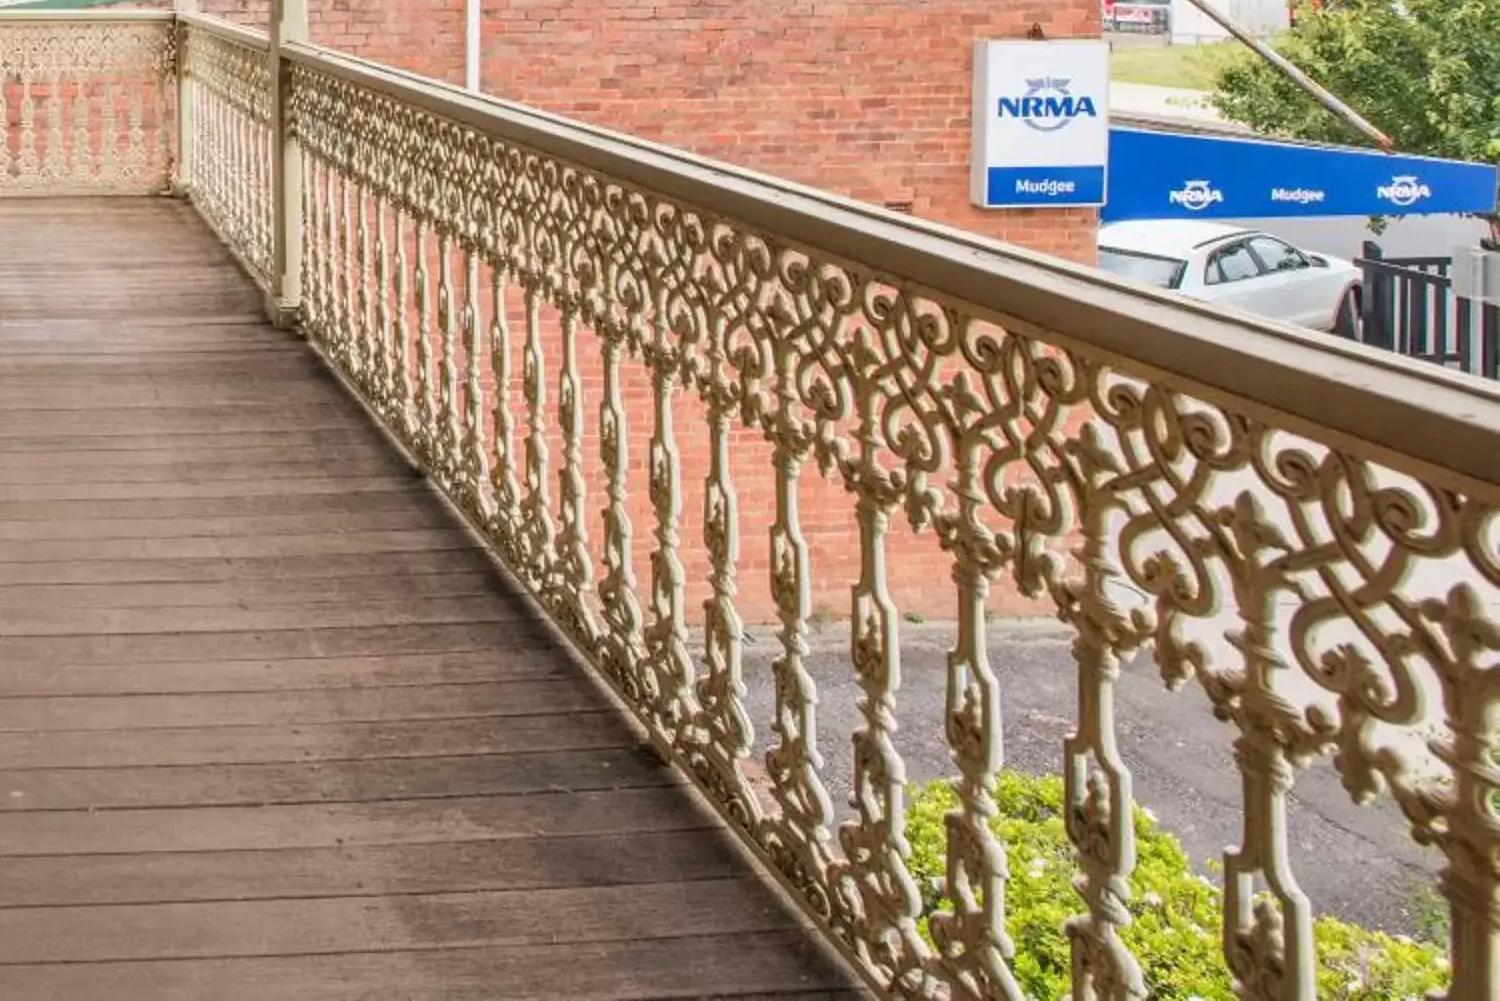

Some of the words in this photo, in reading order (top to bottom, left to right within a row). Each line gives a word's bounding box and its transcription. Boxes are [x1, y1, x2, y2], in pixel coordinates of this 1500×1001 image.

[997, 96, 1097, 118] NRMA
[1015, 178, 1076, 197] Mudgee
[1169, 189, 1224, 204] NRMA
[1271, 187, 1325, 204] Mudgee
[1377, 184, 1432, 200] NRMA
